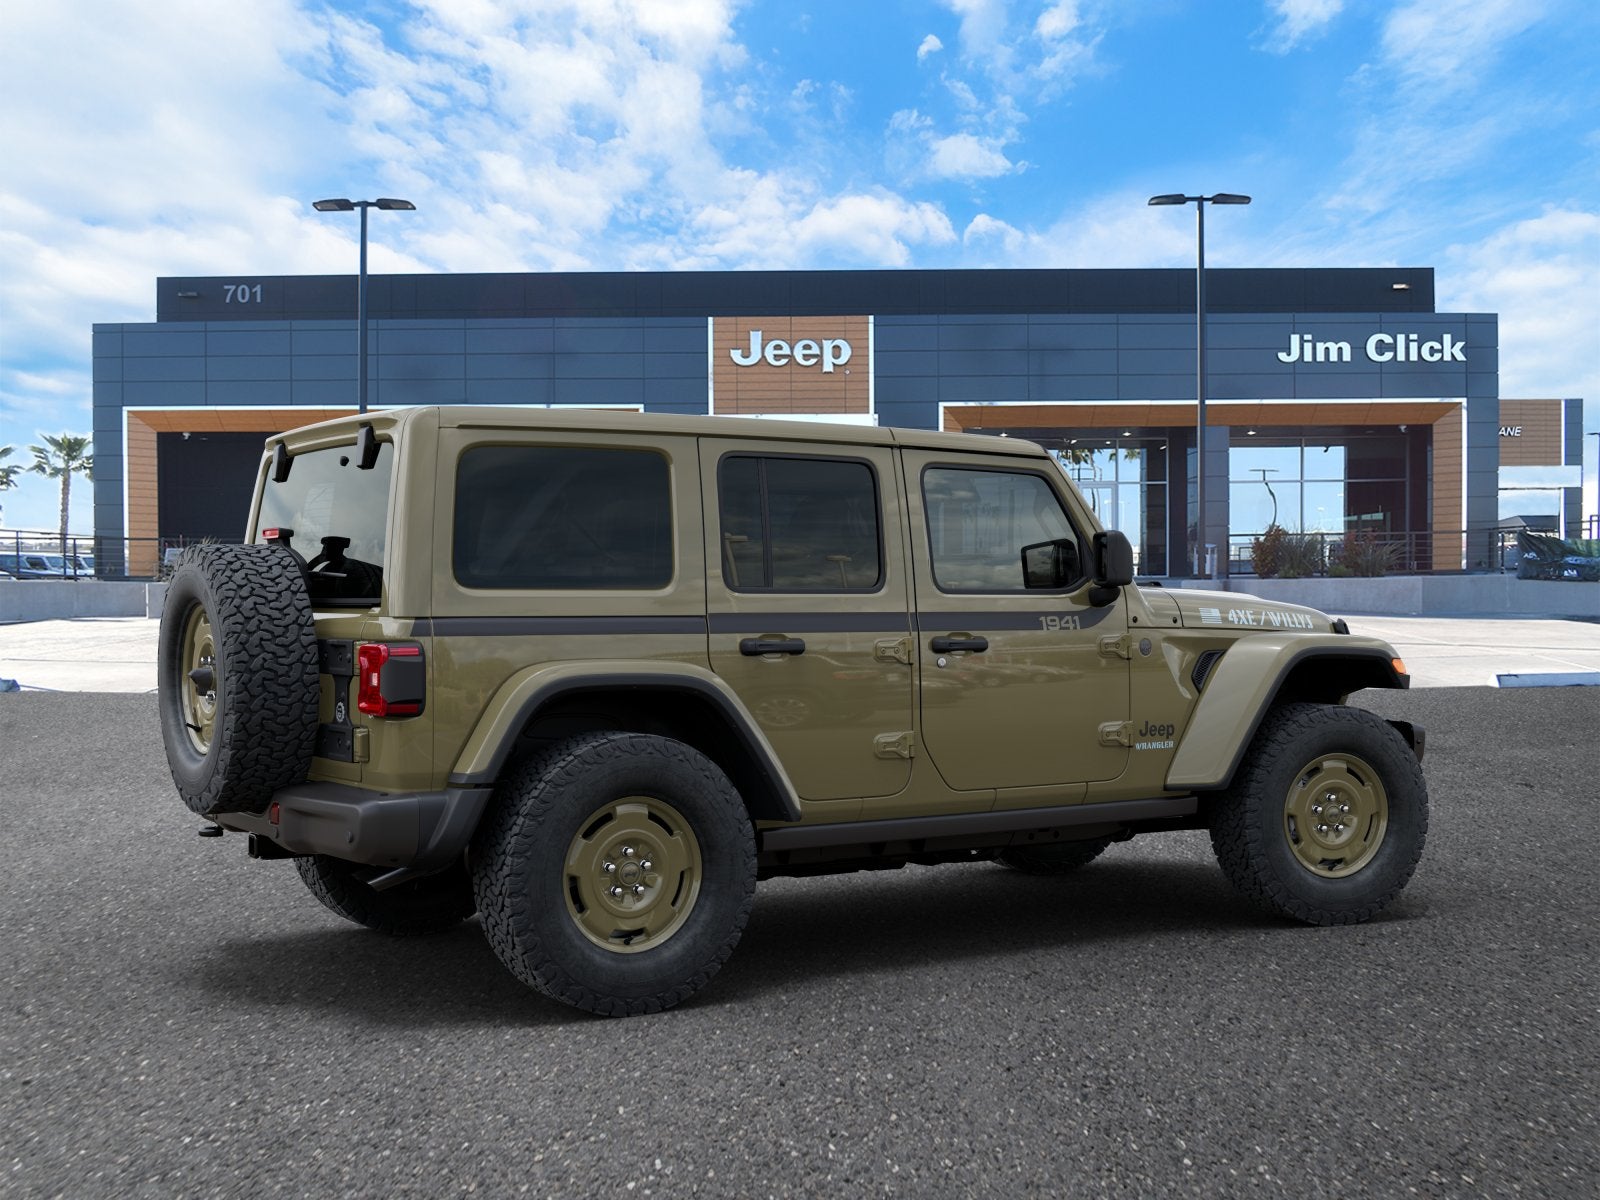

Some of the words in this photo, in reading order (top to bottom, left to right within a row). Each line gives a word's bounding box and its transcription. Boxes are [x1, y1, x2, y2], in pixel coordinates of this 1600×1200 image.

[223, 284, 262, 303] 701
[730, 330, 852, 373] Jeep
[1277, 334, 1351, 362] Jim
[1365, 333, 1467, 362] Click
[1039, 615, 1081, 631] 1941
[1228, 609, 1257, 625] 4XE
[1139, 720, 1175, 739] Jeep
[1135, 740, 1174, 750] WRANGLER
